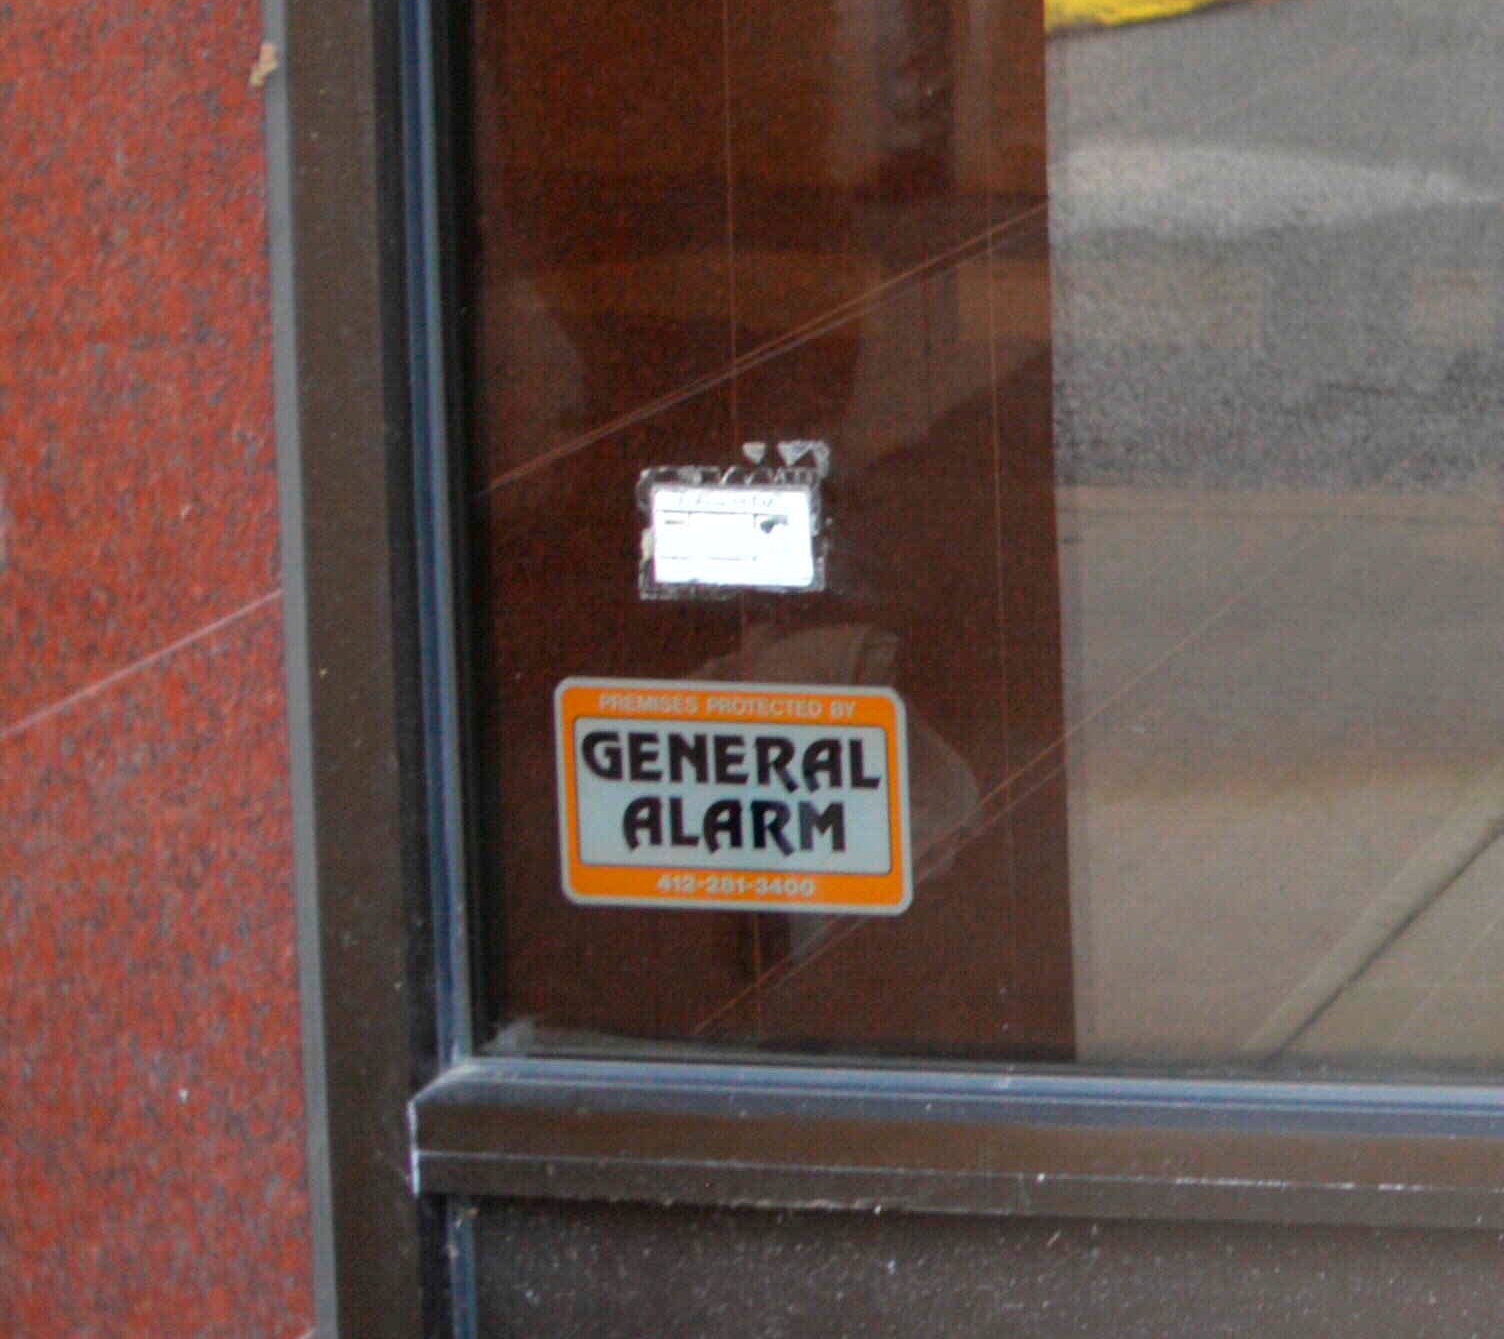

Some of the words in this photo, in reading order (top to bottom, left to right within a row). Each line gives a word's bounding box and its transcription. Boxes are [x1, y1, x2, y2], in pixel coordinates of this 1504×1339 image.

[599, 693, 698, 714] PREMISES
[705, 695, 823, 717] PROTECTED
[830, 699, 857, 718] BY
[581, 730, 881, 794] GENERAL
[622, 796, 847, 857] ALARM
[656, 874, 816, 897] 412-281-3400
